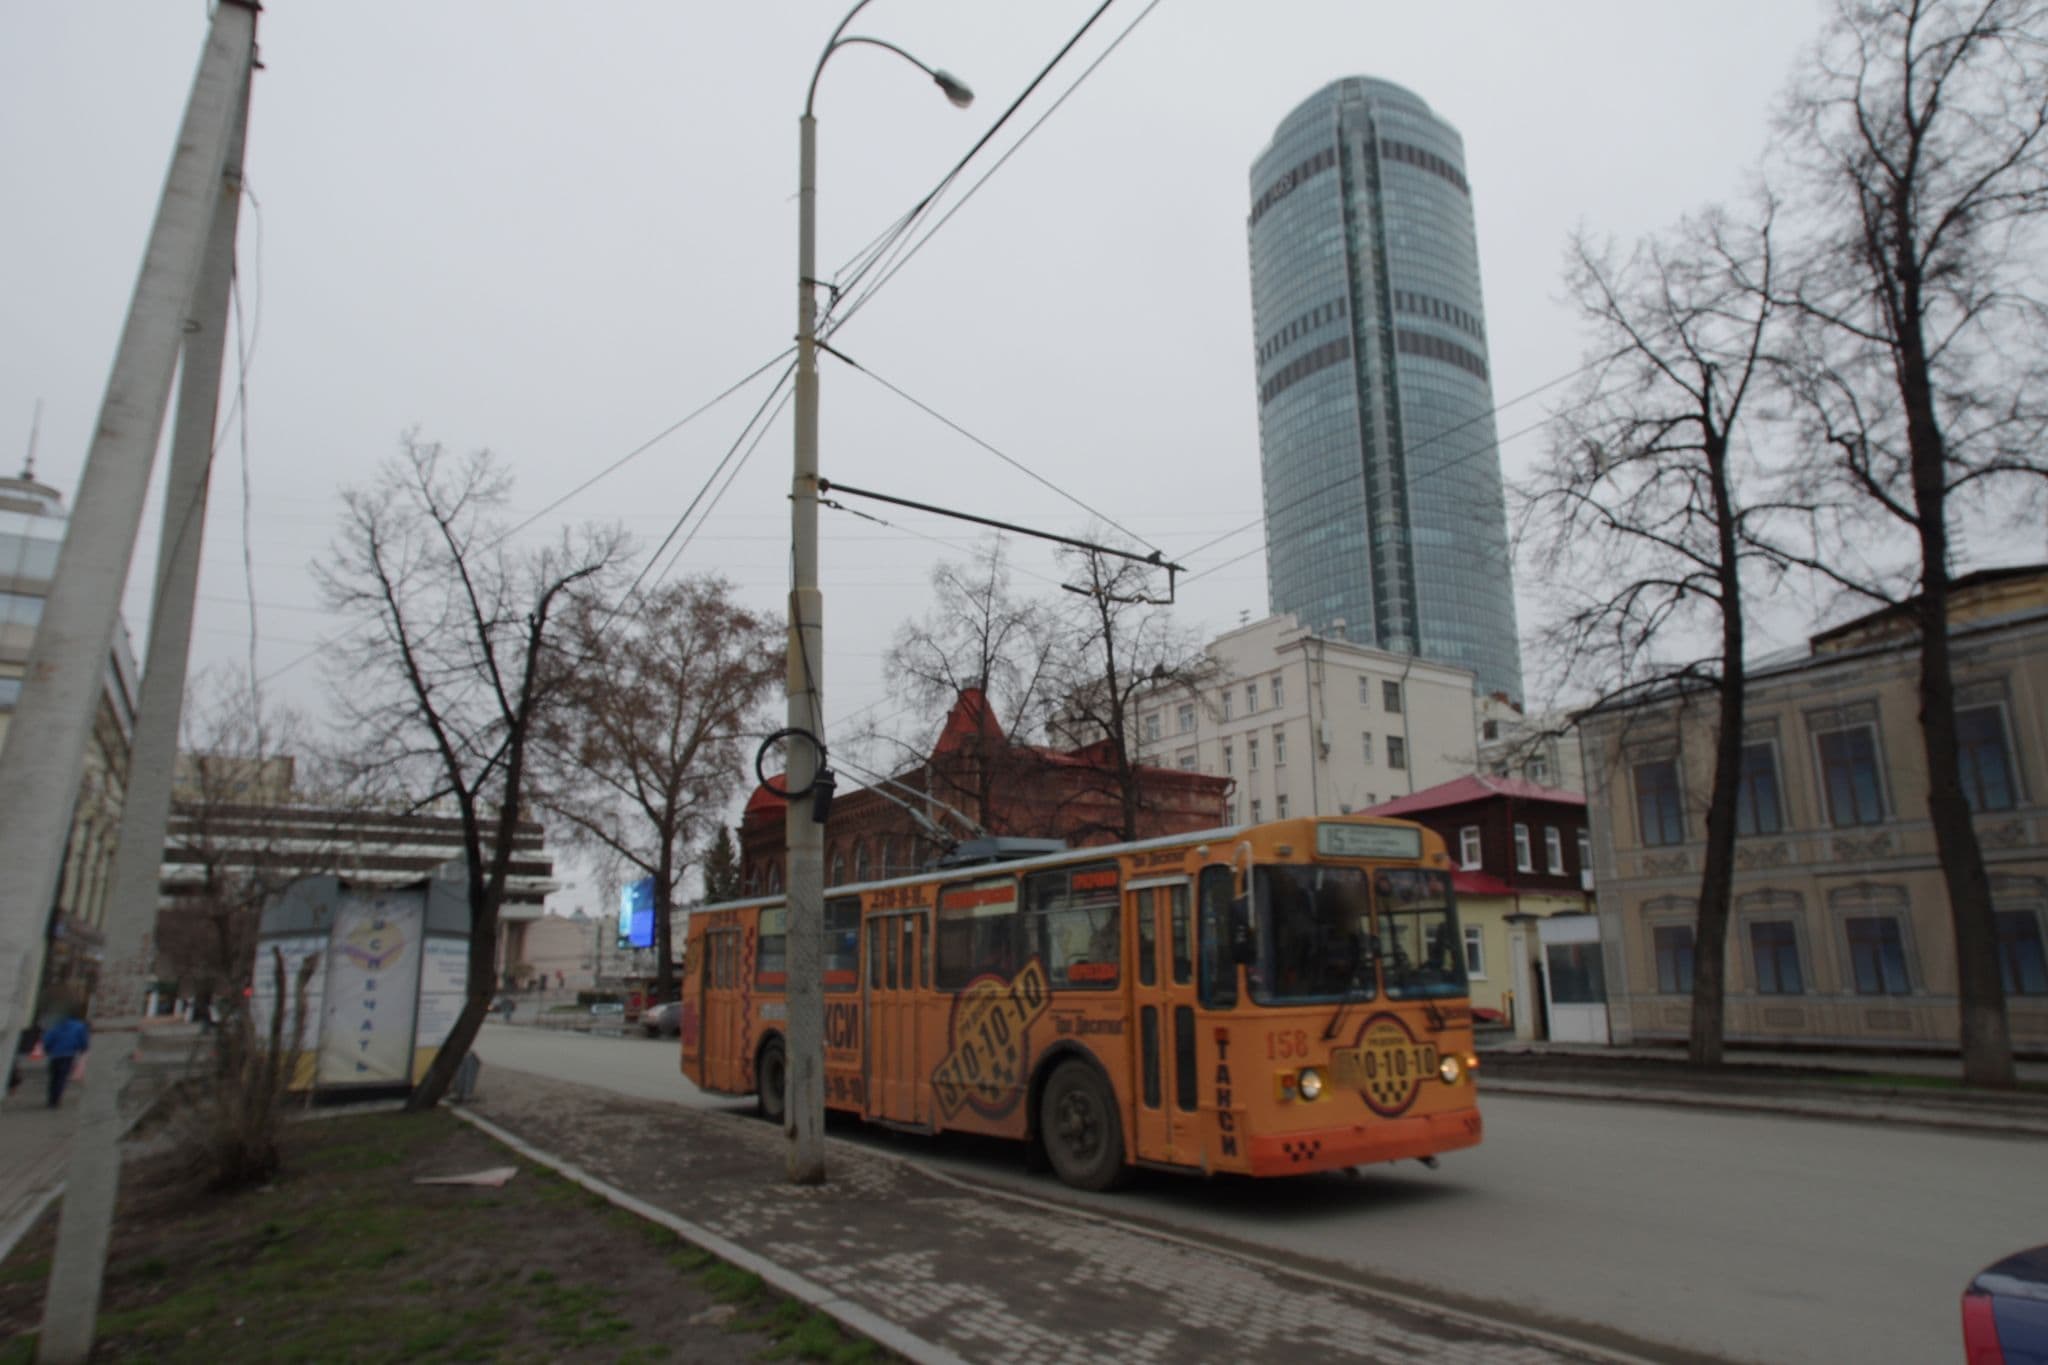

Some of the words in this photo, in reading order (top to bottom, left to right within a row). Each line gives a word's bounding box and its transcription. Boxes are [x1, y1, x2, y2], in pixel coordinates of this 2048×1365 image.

[824, 1003, 859, 1049] КСИ
[938, 966, 1042, 1107] 310-10-10
[1266, 1029, 1308, 1060] 158
